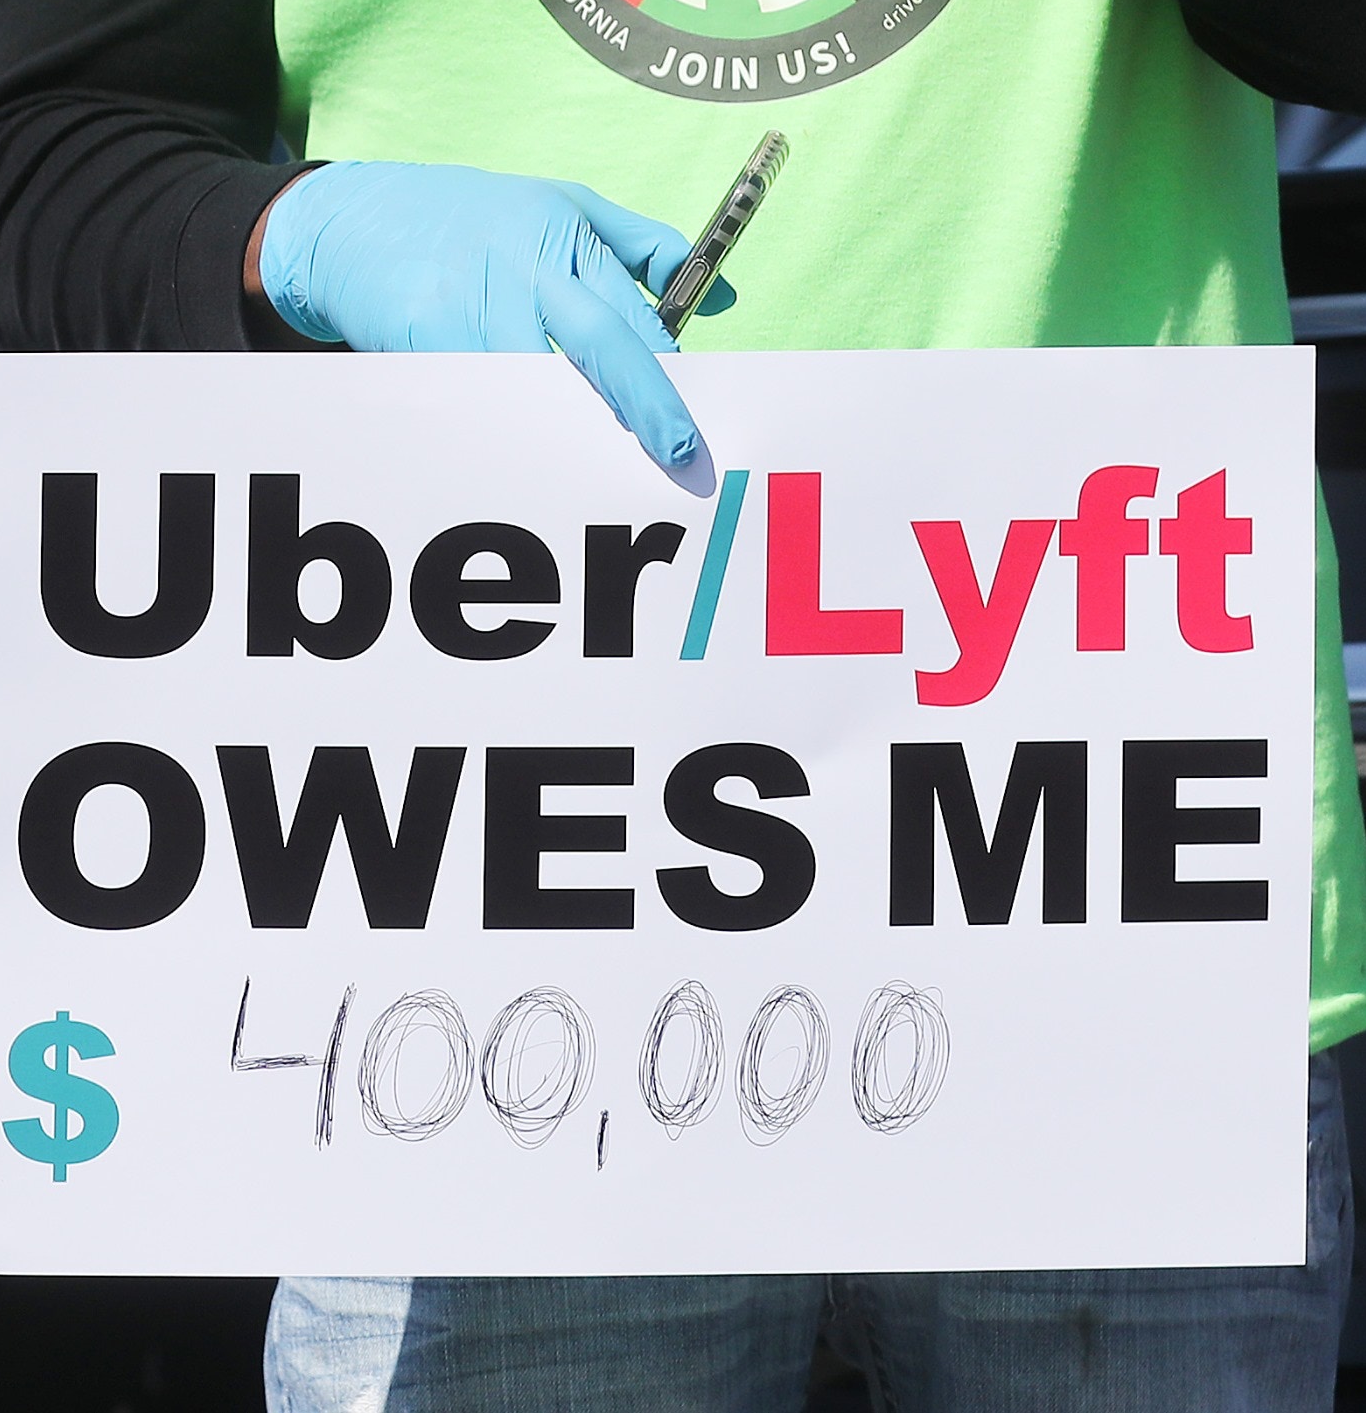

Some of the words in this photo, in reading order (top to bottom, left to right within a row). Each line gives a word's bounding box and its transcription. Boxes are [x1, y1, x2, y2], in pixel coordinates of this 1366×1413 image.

[648, 45, 757, 90] JOIN
[778, 32, 858, 85] US!
[38, 464, 1255, 707] Uber/Lyft
[17, 740, 817, 933] OWES
[888, 738, 1270, 927] ME
[2, 1010, 121, 1183] $
[231, 973, 951, 1173] 400,000
